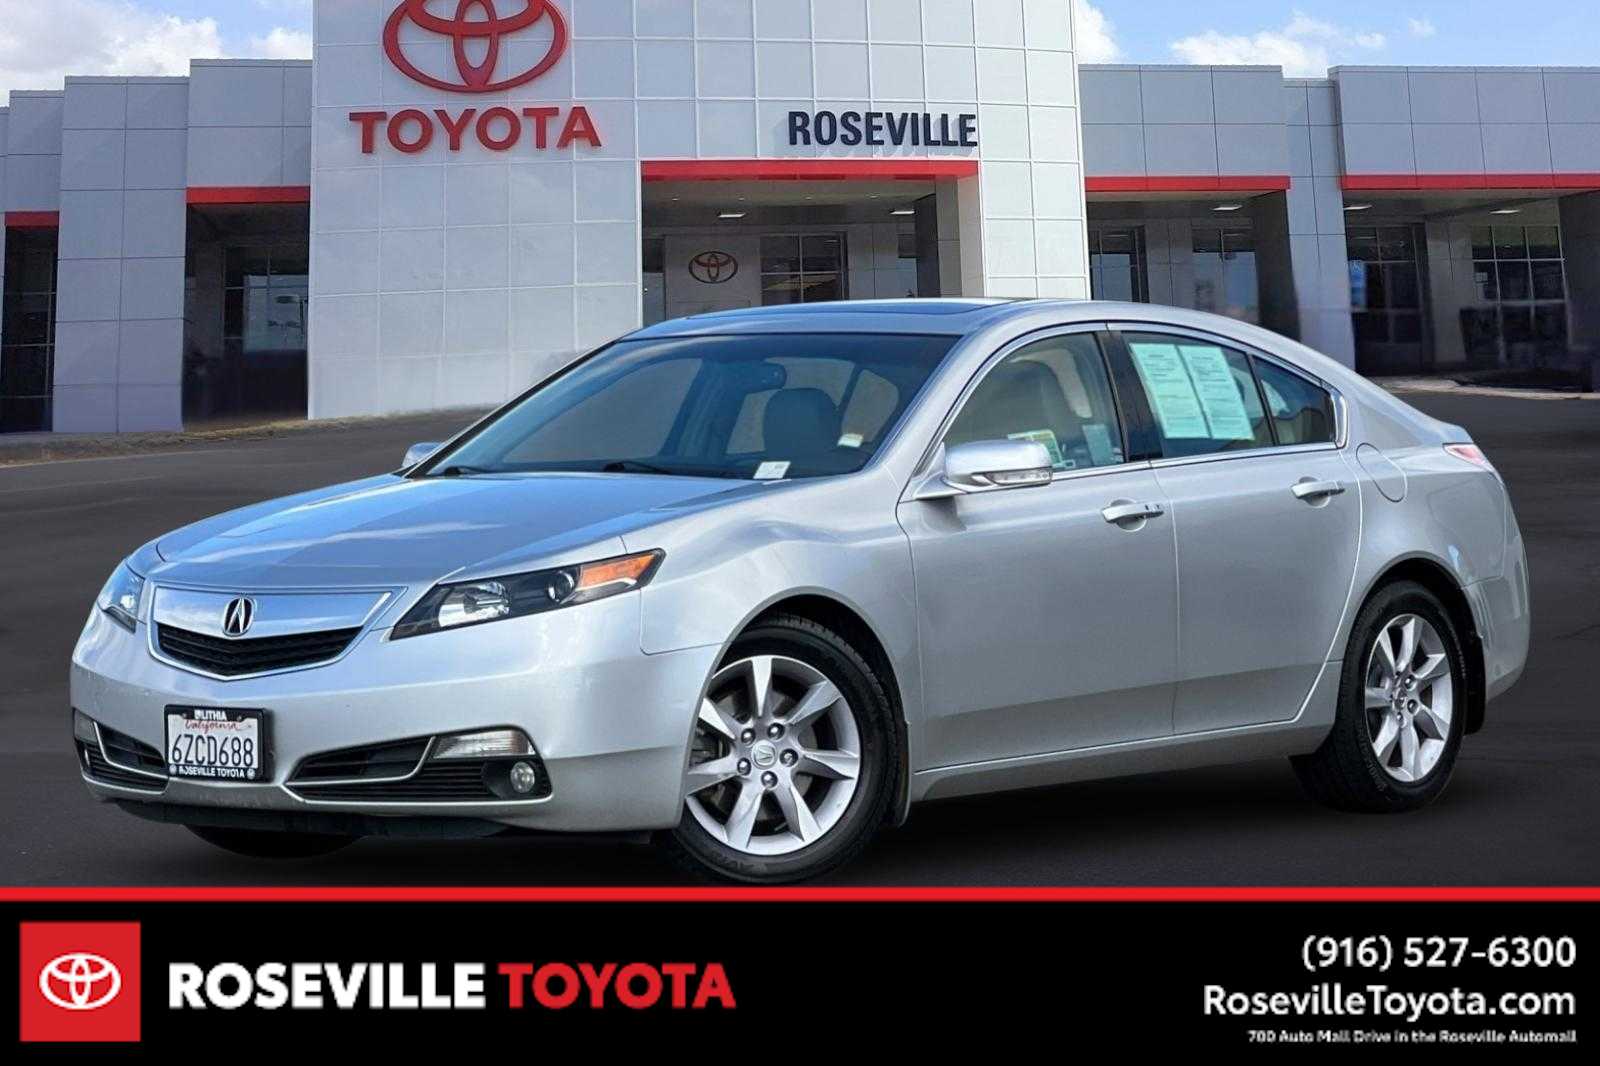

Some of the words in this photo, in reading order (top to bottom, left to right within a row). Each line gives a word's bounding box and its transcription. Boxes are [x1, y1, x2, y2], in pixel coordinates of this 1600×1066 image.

[349, 106, 602, 153] TOYOTA
[788, 110, 978, 147] ROSEVILLE
[185, 719, 241, 735] California
[171, 734, 254, 767] 6ZCD688
[178, 765, 216, 777] ROSEVILLE
[217, 767, 245, 778] TOYOTA
